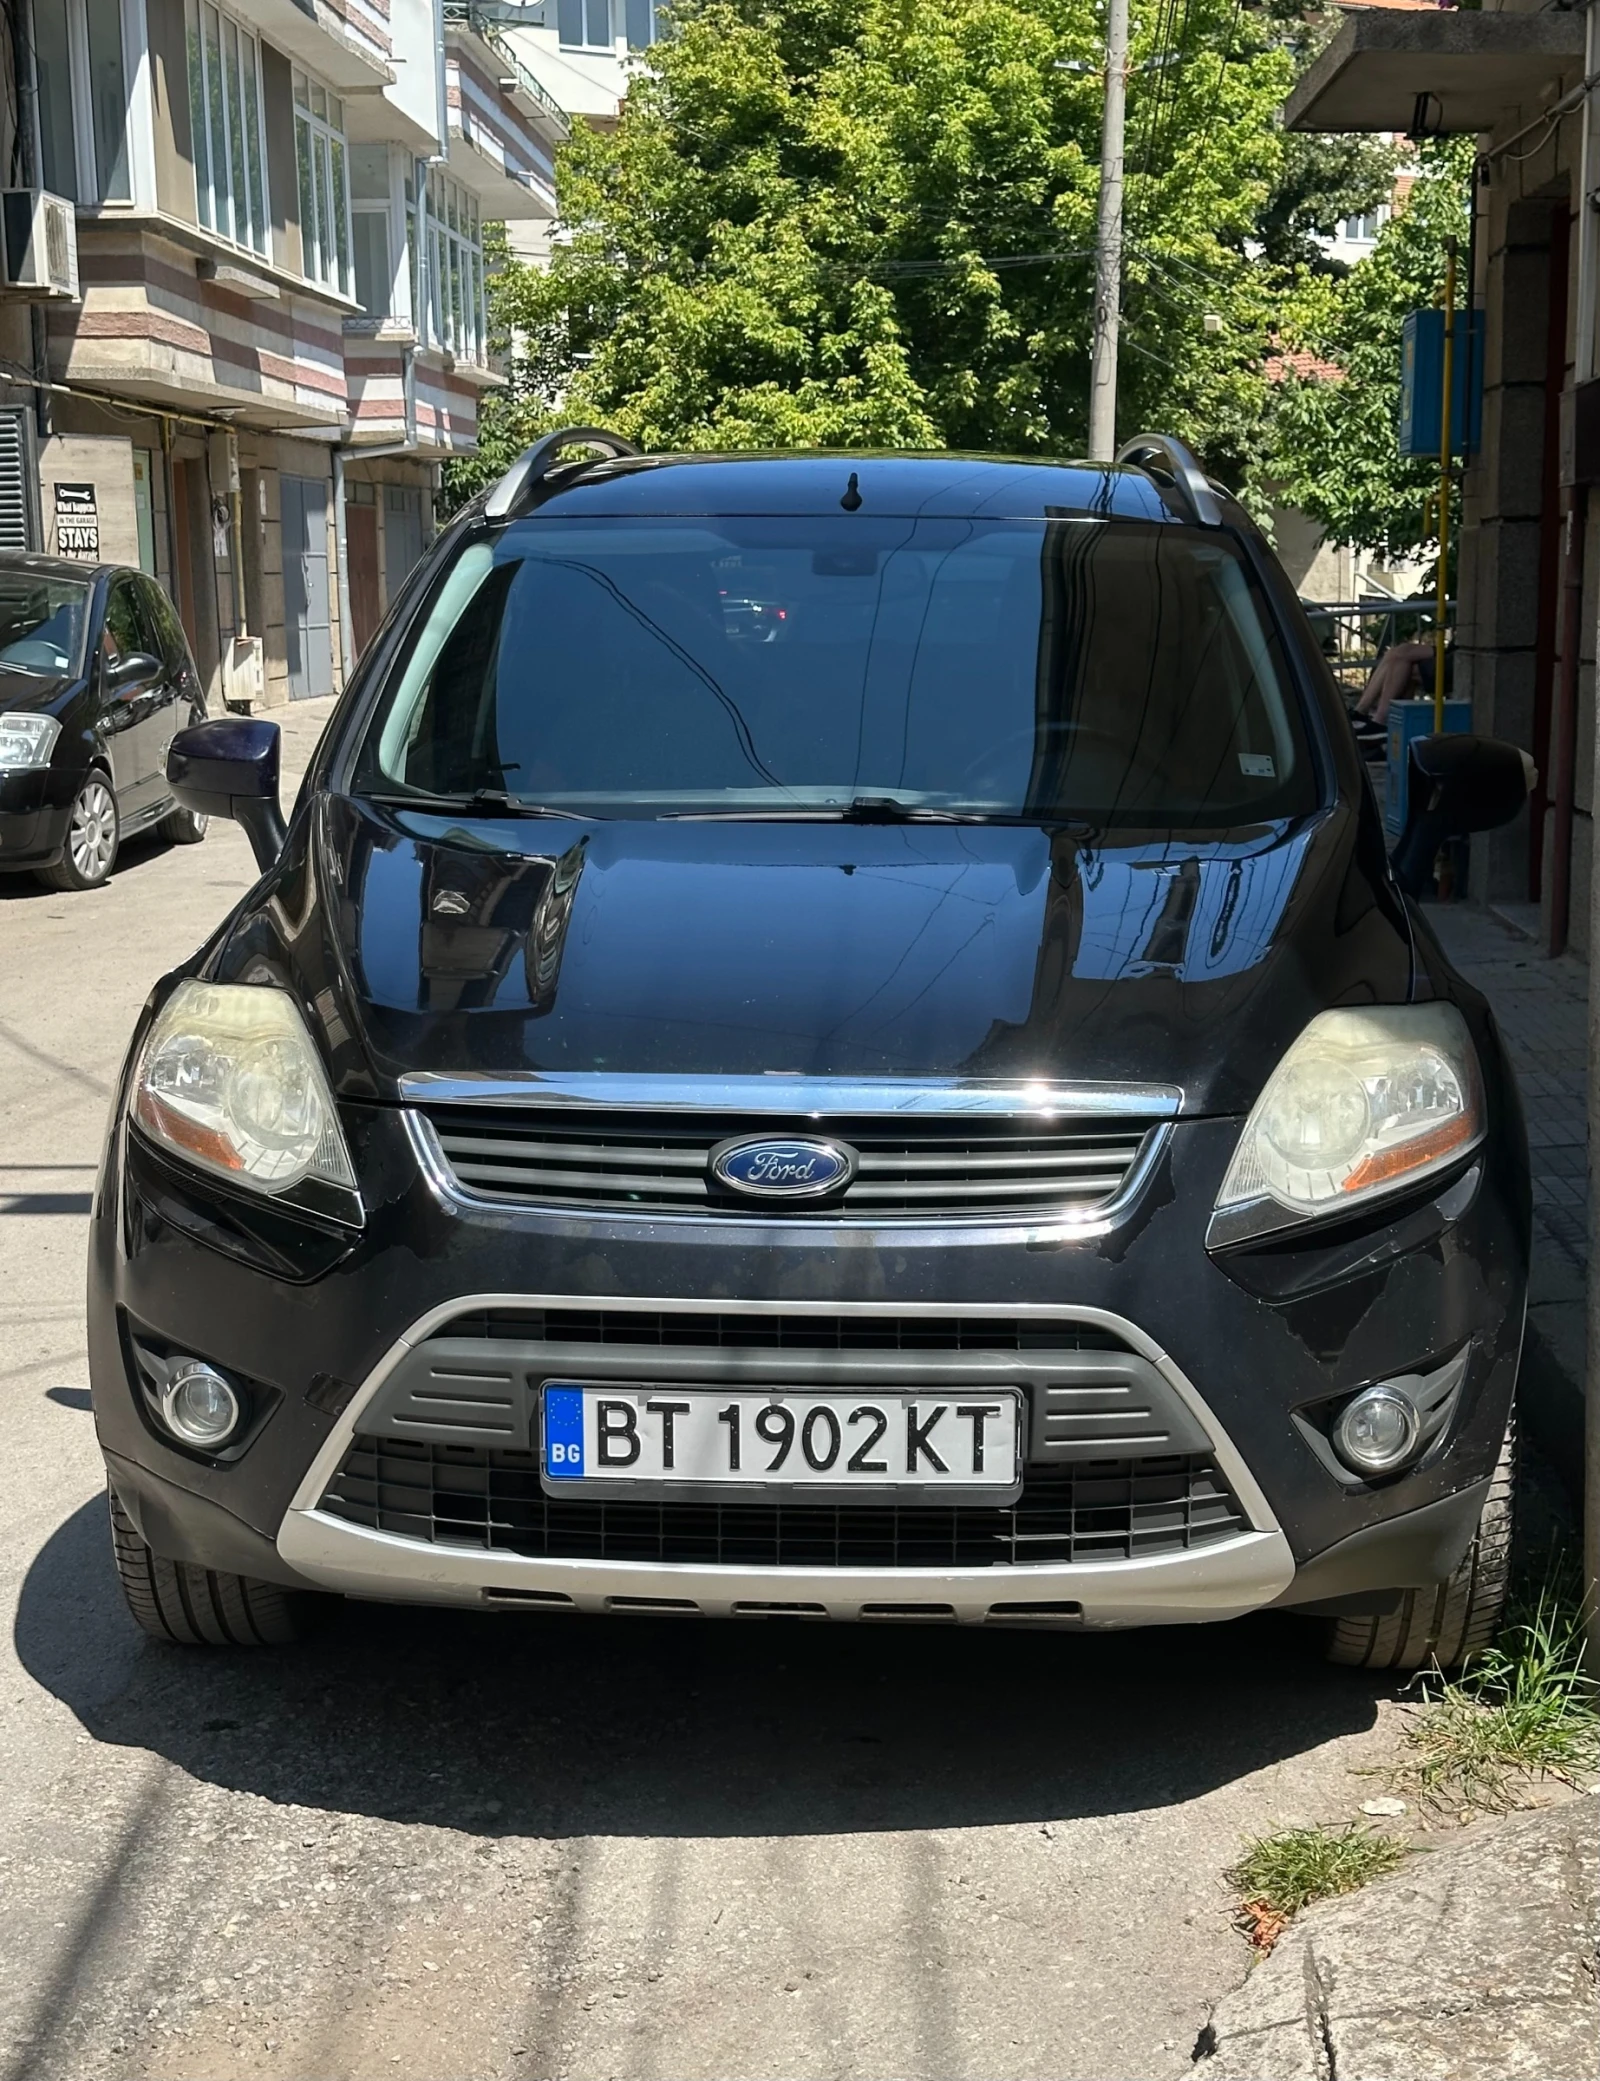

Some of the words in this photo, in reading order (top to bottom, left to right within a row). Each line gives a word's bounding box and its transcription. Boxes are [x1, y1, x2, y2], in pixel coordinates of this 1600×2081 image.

[59, 528, 97, 548] STAYS
[747, 1152, 816, 1180] Ford
[552, 1443, 580, 1463] BG
